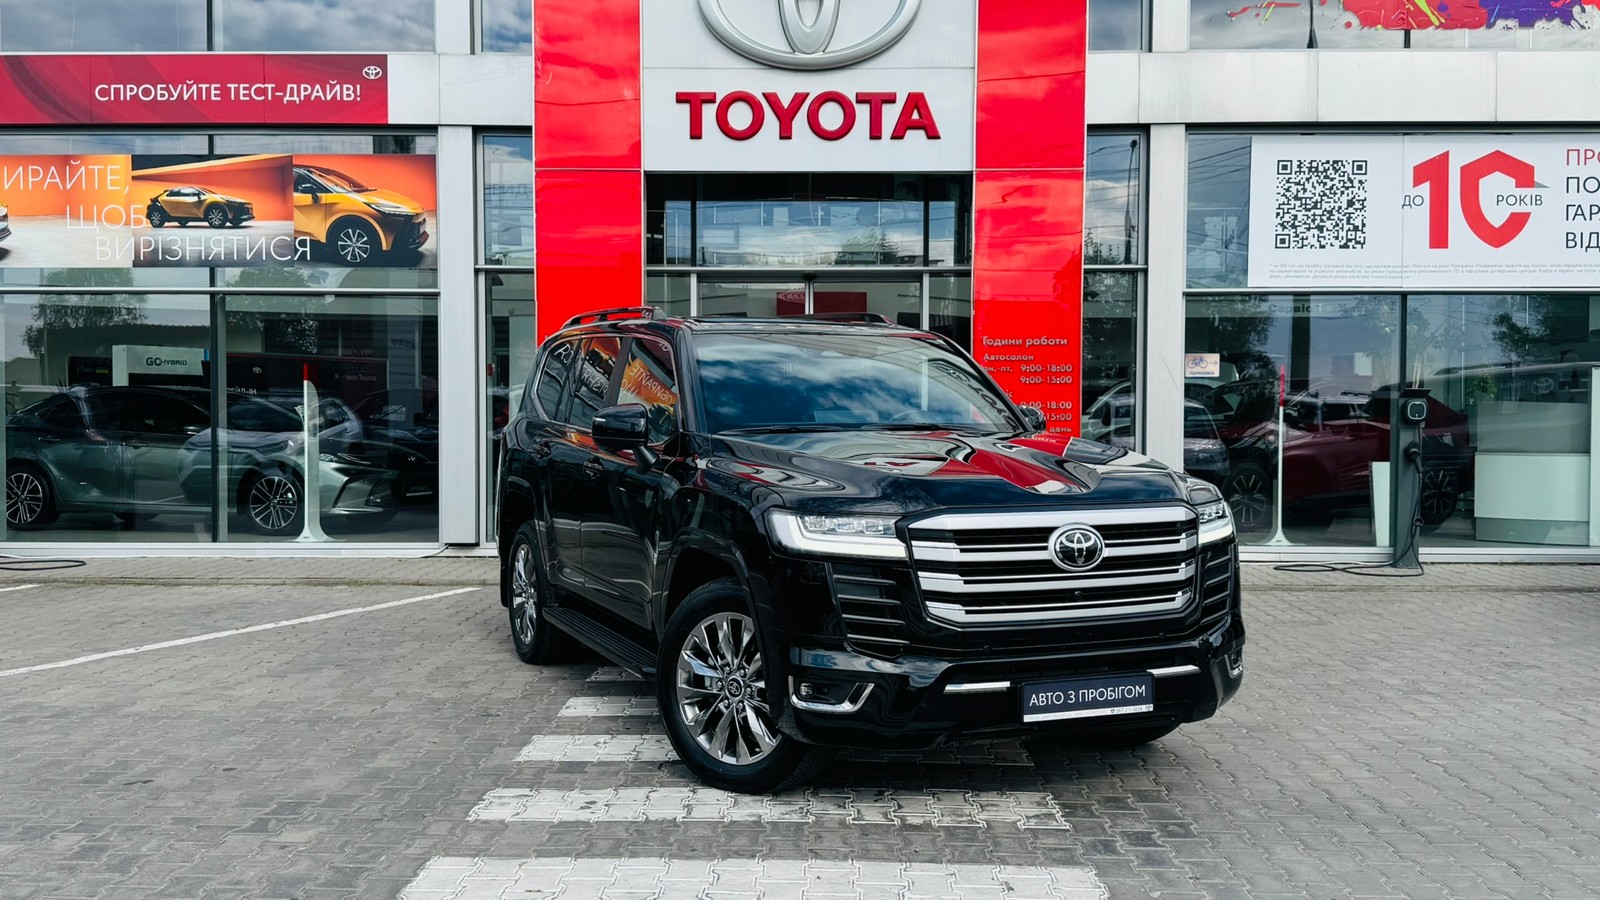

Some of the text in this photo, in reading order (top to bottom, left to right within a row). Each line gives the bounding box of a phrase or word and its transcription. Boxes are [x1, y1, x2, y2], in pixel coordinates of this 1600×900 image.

[94, 80, 361, 104] СПРОБУЙТЕ ТЕСТ-ДРАЙВ!
[675, 90, 942, 141] TOYOTA
[3, 159, 130, 194] ИРАЙТЕ,
[1401, 194, 1425, 210] ДО
[1496, 194, 1543, 207] РОКІВ
[1565, 203, 1600, 222] ГАР
[66, 204, 146, 234] ЩОБ
[96, 236, 311, 262] ВИРІЗНЯТИСЯ
[982, 335, 1068, 348] Години роботи
[983, 352, 1034, 362] Автосалон
[1029, 691, 1065, 707] АВТО
[1079, 684, 1146, 703] ПРОБІГОМ
